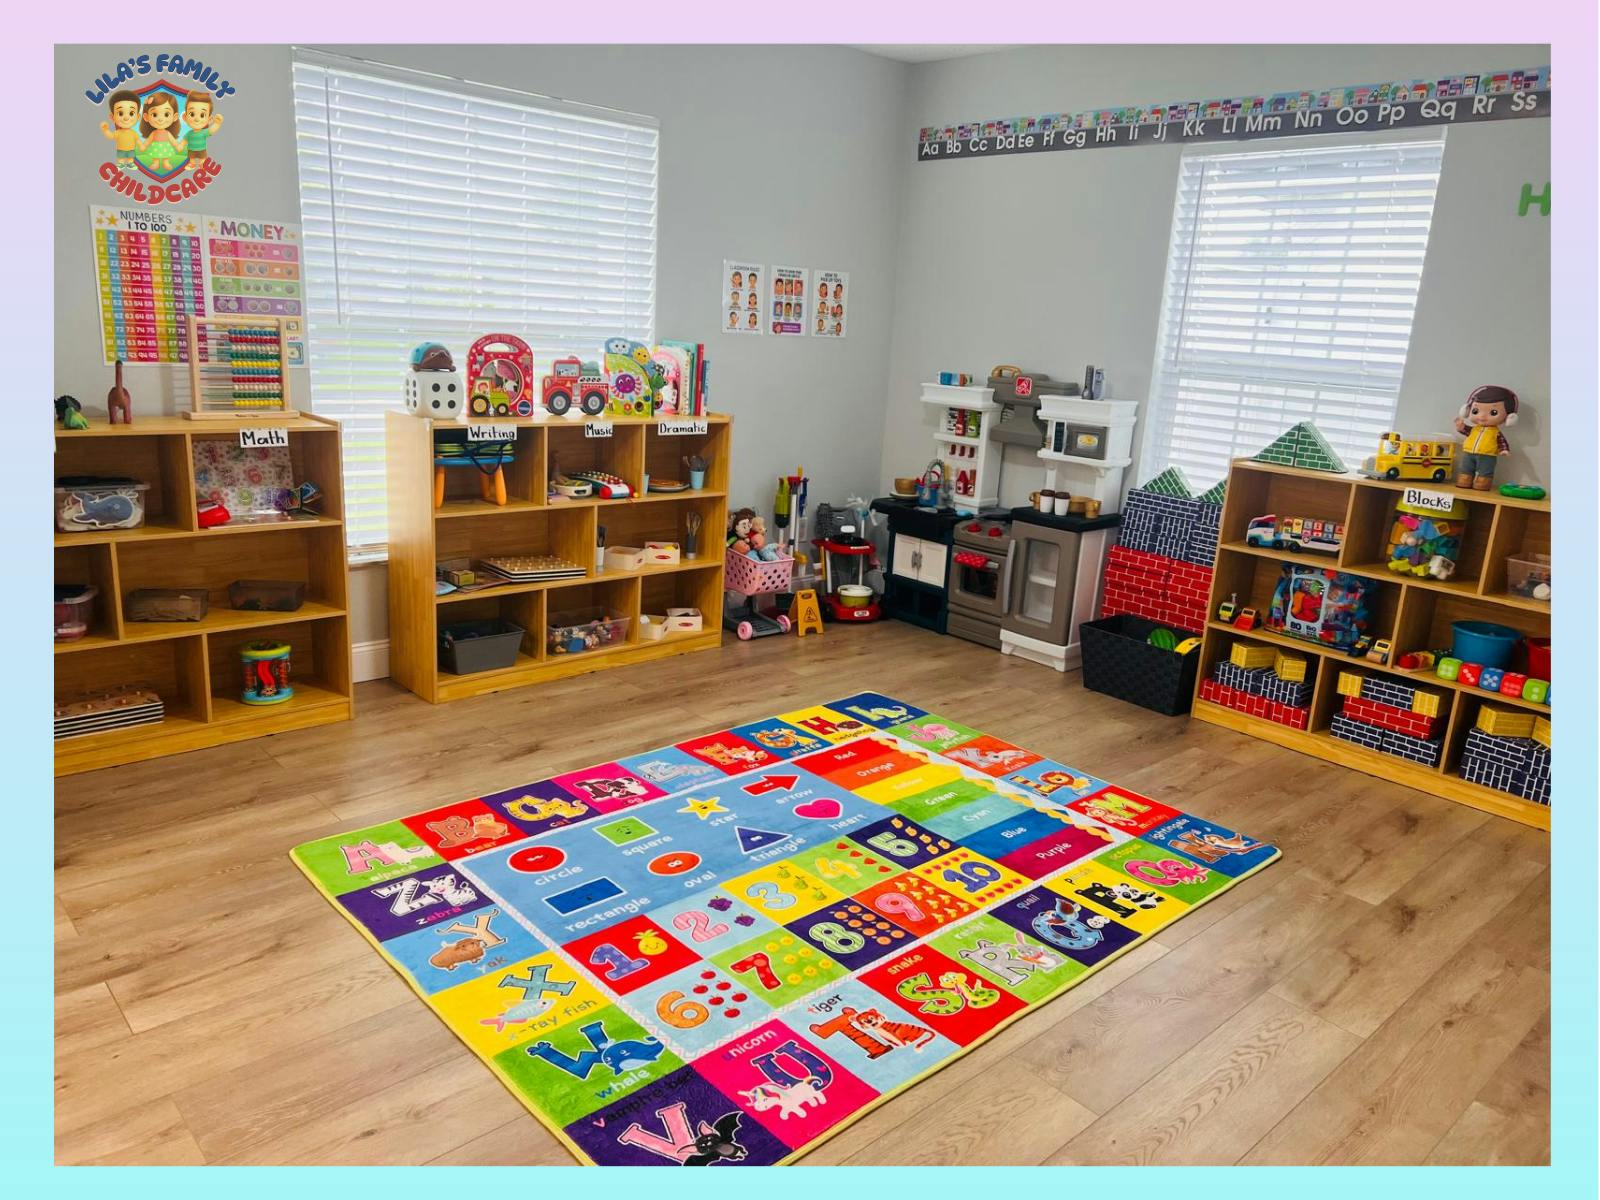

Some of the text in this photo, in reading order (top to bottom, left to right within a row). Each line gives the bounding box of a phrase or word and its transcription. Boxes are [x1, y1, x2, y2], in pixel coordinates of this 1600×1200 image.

[922, 142, 939, 156] Aa
[946, 140, 962, 154] Bb
[969, 138, 988, 152] Cc
[996, 135, 1015, 150] Dd
[1018, 134, 1034, 148] Ee
[1043, 131, 1055, 147] Ff
[1063, 130, 1086, 148] Gg
[1095, 127, 1116, 143] Hh
[1128, 125, 1138, 141] Ii
[1152, 123, 1167, 142] Jj
[1182, 119, 1205, 137] Kk
[1245, 114, 1282, 133] Mm
[1294, 111, 1322, 129] Nn
[1336, 106, 1369, 126] Oo
[1377, 103, 1405, 125] Pp
[1420, 99, 1457, 120] Qq
[1472, 94, 1497, 114] Rr
[1510, 91, 1537, 112] Ss
[120, 210, 173, 225] NUMBERS
[132, 221, 147, 232] TO
[150, 222, 168, 233] 100
[220, 220, 285, 241] MONEY
[241, 430, 286, 446] Math
[469, 426, 516, 441] Writing
[585, 423, 614, 437] Music
[659, 422, 706, 434] Dramatic
[797, 716, 838, 736] H
[833, 751, 858, 762] Red
[856, 761, 896, 778] Orange
[775, 788, 814, 805] arrow
[924, 790, 958, 807] Green
[709, 812, 740, 828] star
[829, 813, 868, 830] heart
[962, 808, 992, 823] Cyan
[426, 816, 476, 849] B
[621, 834, 674, 857] square
[866, 831, 919, 858] 5
[1000, 826, 1028, 840] Blue
[340, 840, 396, 875] A
[750, 835, 807, 863] triangle
[1035, 842, 1073, 860] Purple
[534, 864, 584, 886] circle
[683, 871, 717, 889] oval
[815, 856, 862, 879] 4
[941, 860, 1002, 893] 10
[371, 877, 444, 917] Z
[746, 881, 797, 910] 3
[874, 892, 926, 922] 9
[415, 906, 463, 926] zebra
[564, 895, 651, 932] rectangle
[672, 910, 730, 943] 2
[436, 908, 508, 949] Y
[808, 921, 866, 954] 8
[589, 943, 650, 981] 1
[729, 951, 783, 991] 7
[886, 953, 924, 976] snake
[958, 939, 1036, 987] R
[807, 992, 842, 1015] tiger
[895, 972, 965, 1017] S
[507, 998, 598, 1042] x-ray fish
[655, 990, 709, 1029] 6
[721, 1028, 777, 1062] unicorn
[808, 1006, 895, 1060] T
[525, 1021, 612, 1081] W
[750, 1040, 834, 1092] U
[594, 1069, 651, 1099] whale
[617, 1101, 698, 1166] V
